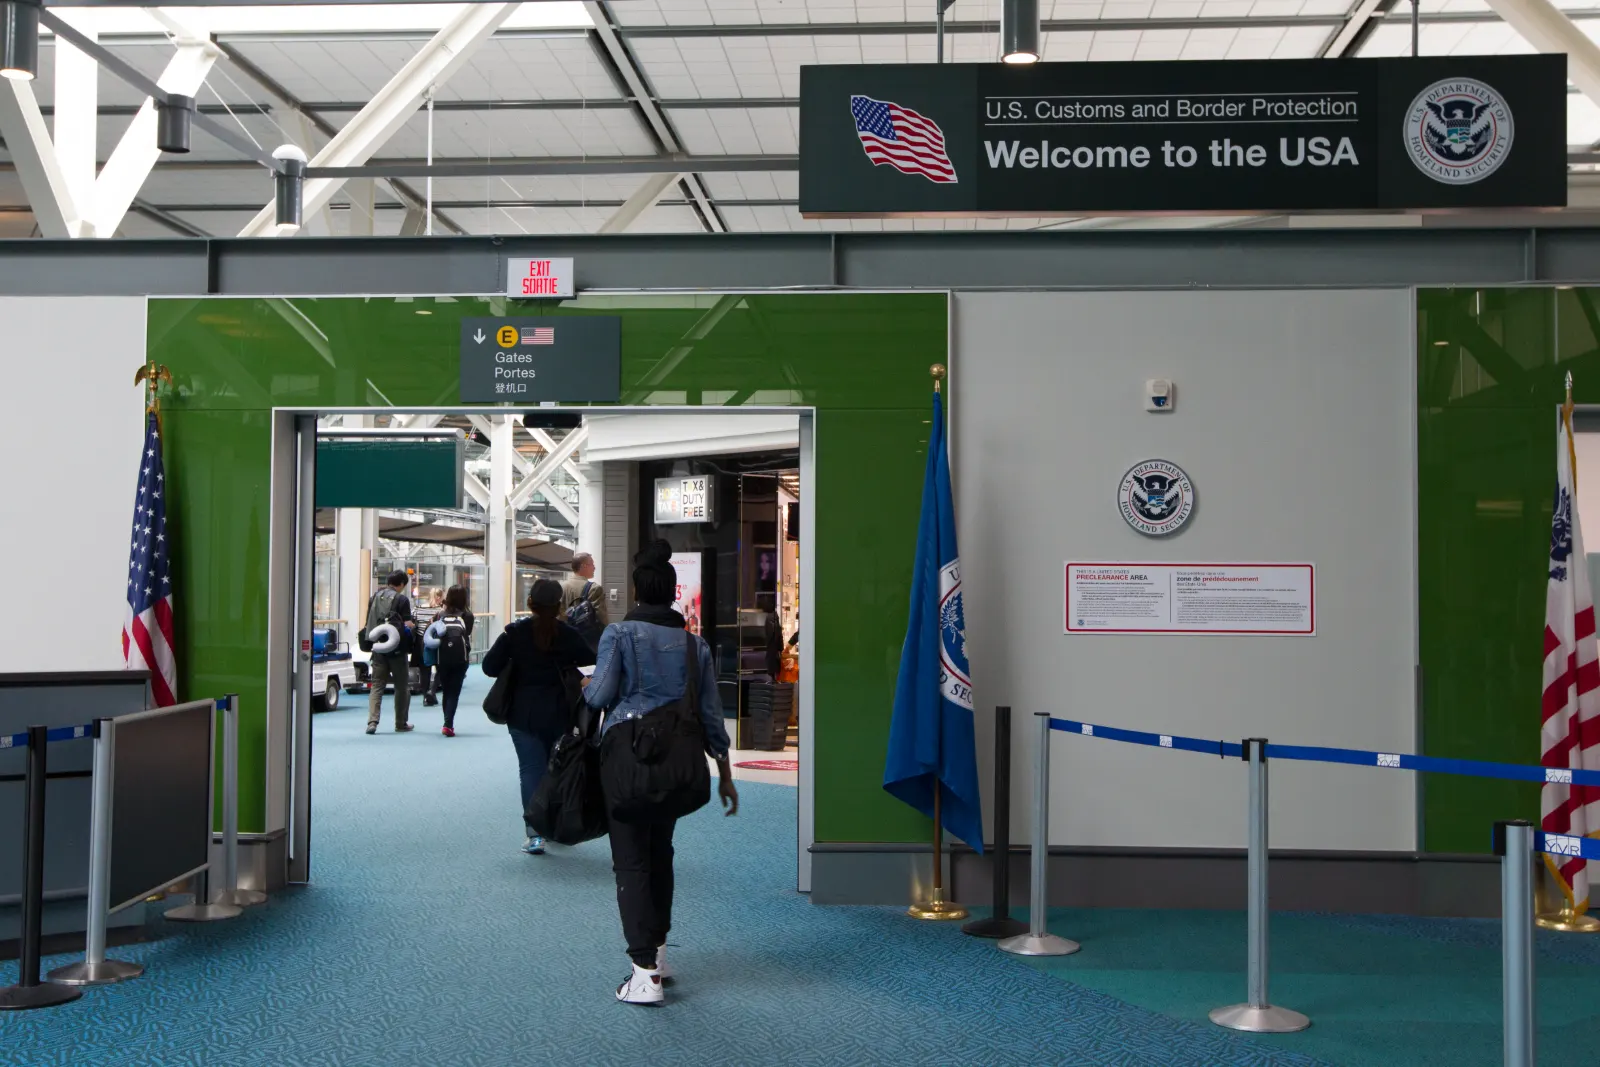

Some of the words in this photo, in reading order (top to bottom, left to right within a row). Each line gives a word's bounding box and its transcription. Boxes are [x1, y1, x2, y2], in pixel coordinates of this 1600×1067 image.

[986, 101, 1027, 119] U.S.
[1035, 100, 1125, 119] Customs
[1131, 100, 1169, 118] and
[1177, 99, 1246, 117] Border
[1252, 97, 1357, 116] Protection
[1411, 107, 1426, 123] U.S.
[1428, 84, 1499, 108] DEPARTMENT
[1496, 109, 1507, 123] OF
[984, 140, 1151, 168] Welcome
[1161, 140, 1198, 167] to
[1208, 138, 1267, 167] the
[1279, 136, 1360, 166] USA
[1411, 136, 1460, 178] HOMELAND
[1465, 134, 1507, 177] SECURITY
[529, 260, 551, 277] EXIT
[522, 278, 558, 294] SORTIE
[501, 330, 513, 344] E
[495, 352, 533, 363] Gates
[494, 367, 536, 379] Portes
[495, 383, 527, 394] 登机口
[1134, 463, 1187, 482] DEPARTMENT
[1182, 482, 1191, 493] OF
[683, 493, 704, 505] DUTY
[683, 506, 704, 518] FREE
[1121, 501, 1157, 533] HOMELAND
[1160, 501, 1191, 533] SECURITY
[1378, 758, 1400, 768] YVR
[1545, 773, 1571, 784] YVR
[1545, 839, 1580, 856] YVR
